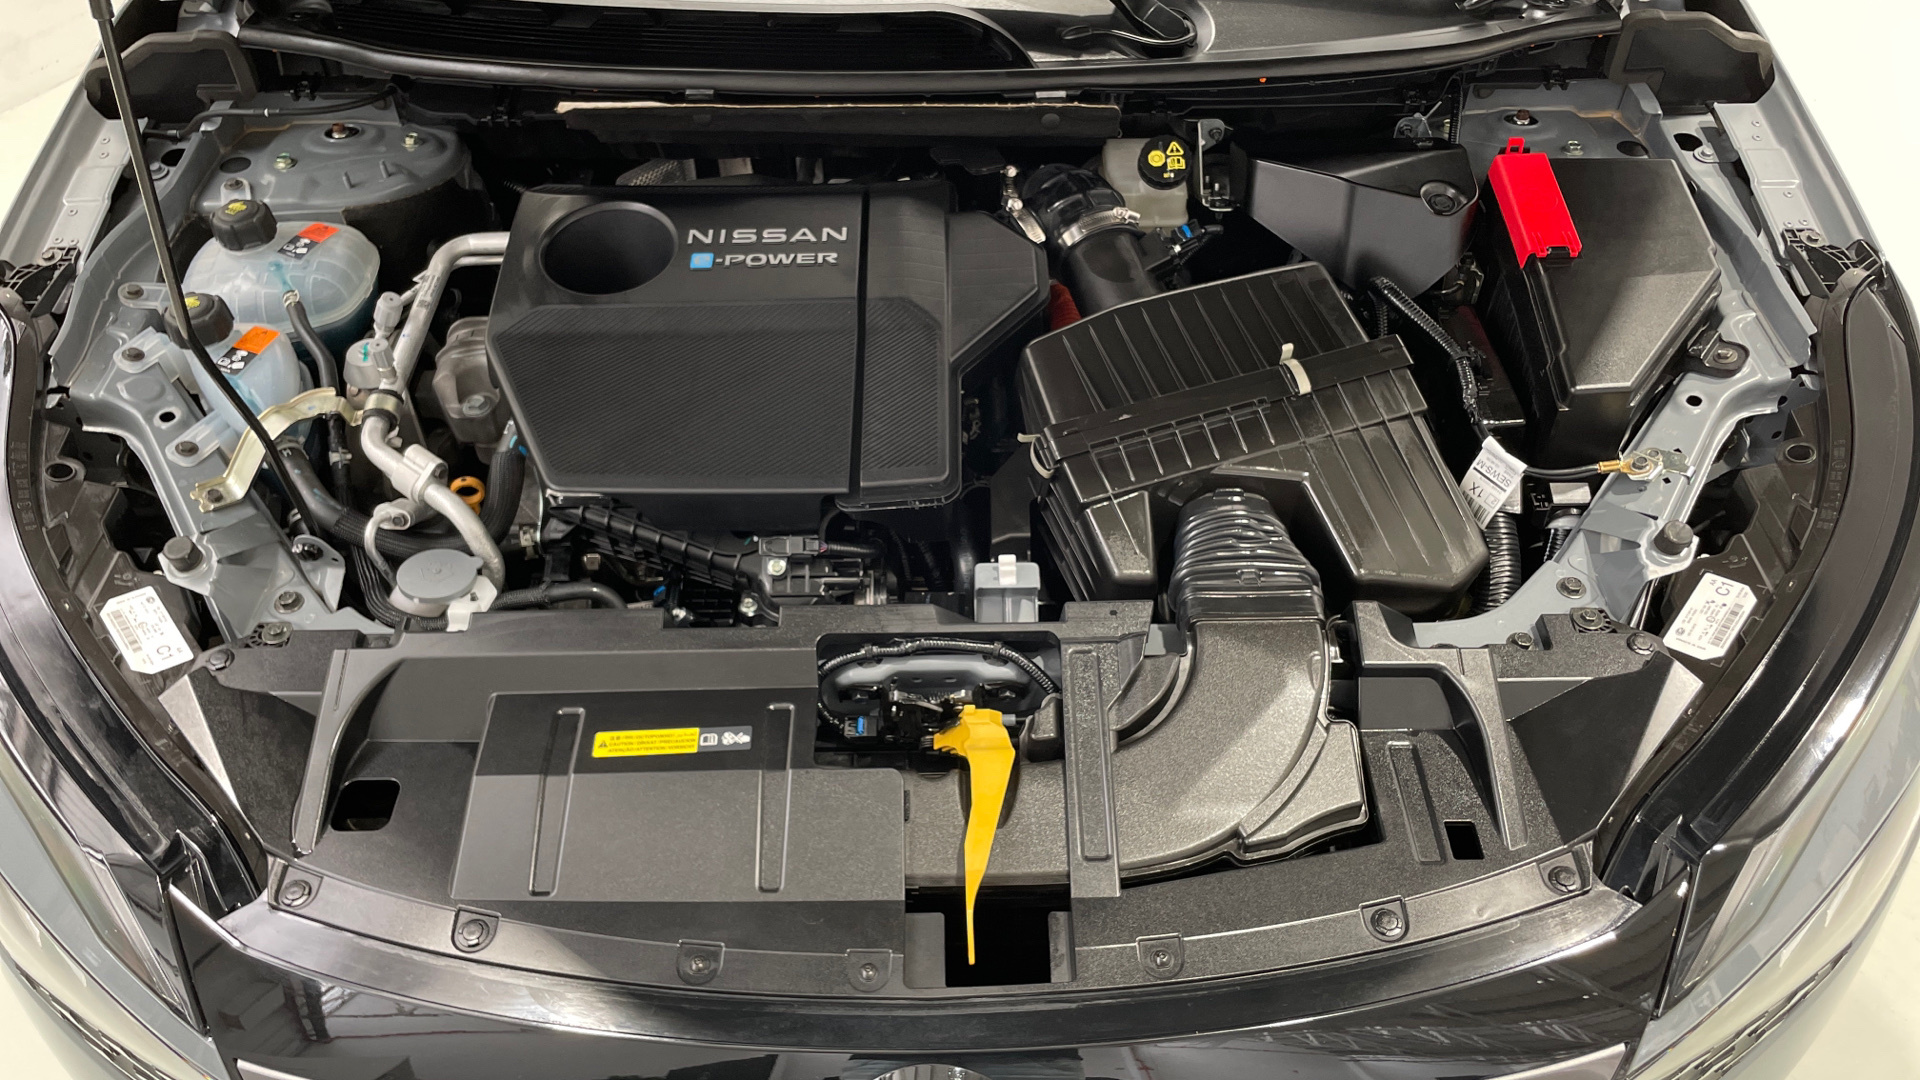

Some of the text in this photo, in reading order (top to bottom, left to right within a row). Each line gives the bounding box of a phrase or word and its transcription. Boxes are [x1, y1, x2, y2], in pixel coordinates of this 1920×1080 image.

[687, 226, 848, 245] NISSAN
[1476, 459, 1512, 488] SEWS-M
[1469, 481, 1484, 498] 1X
[1715, 581, 1735, 596] C1
[156, 645, 174, 661] C1
